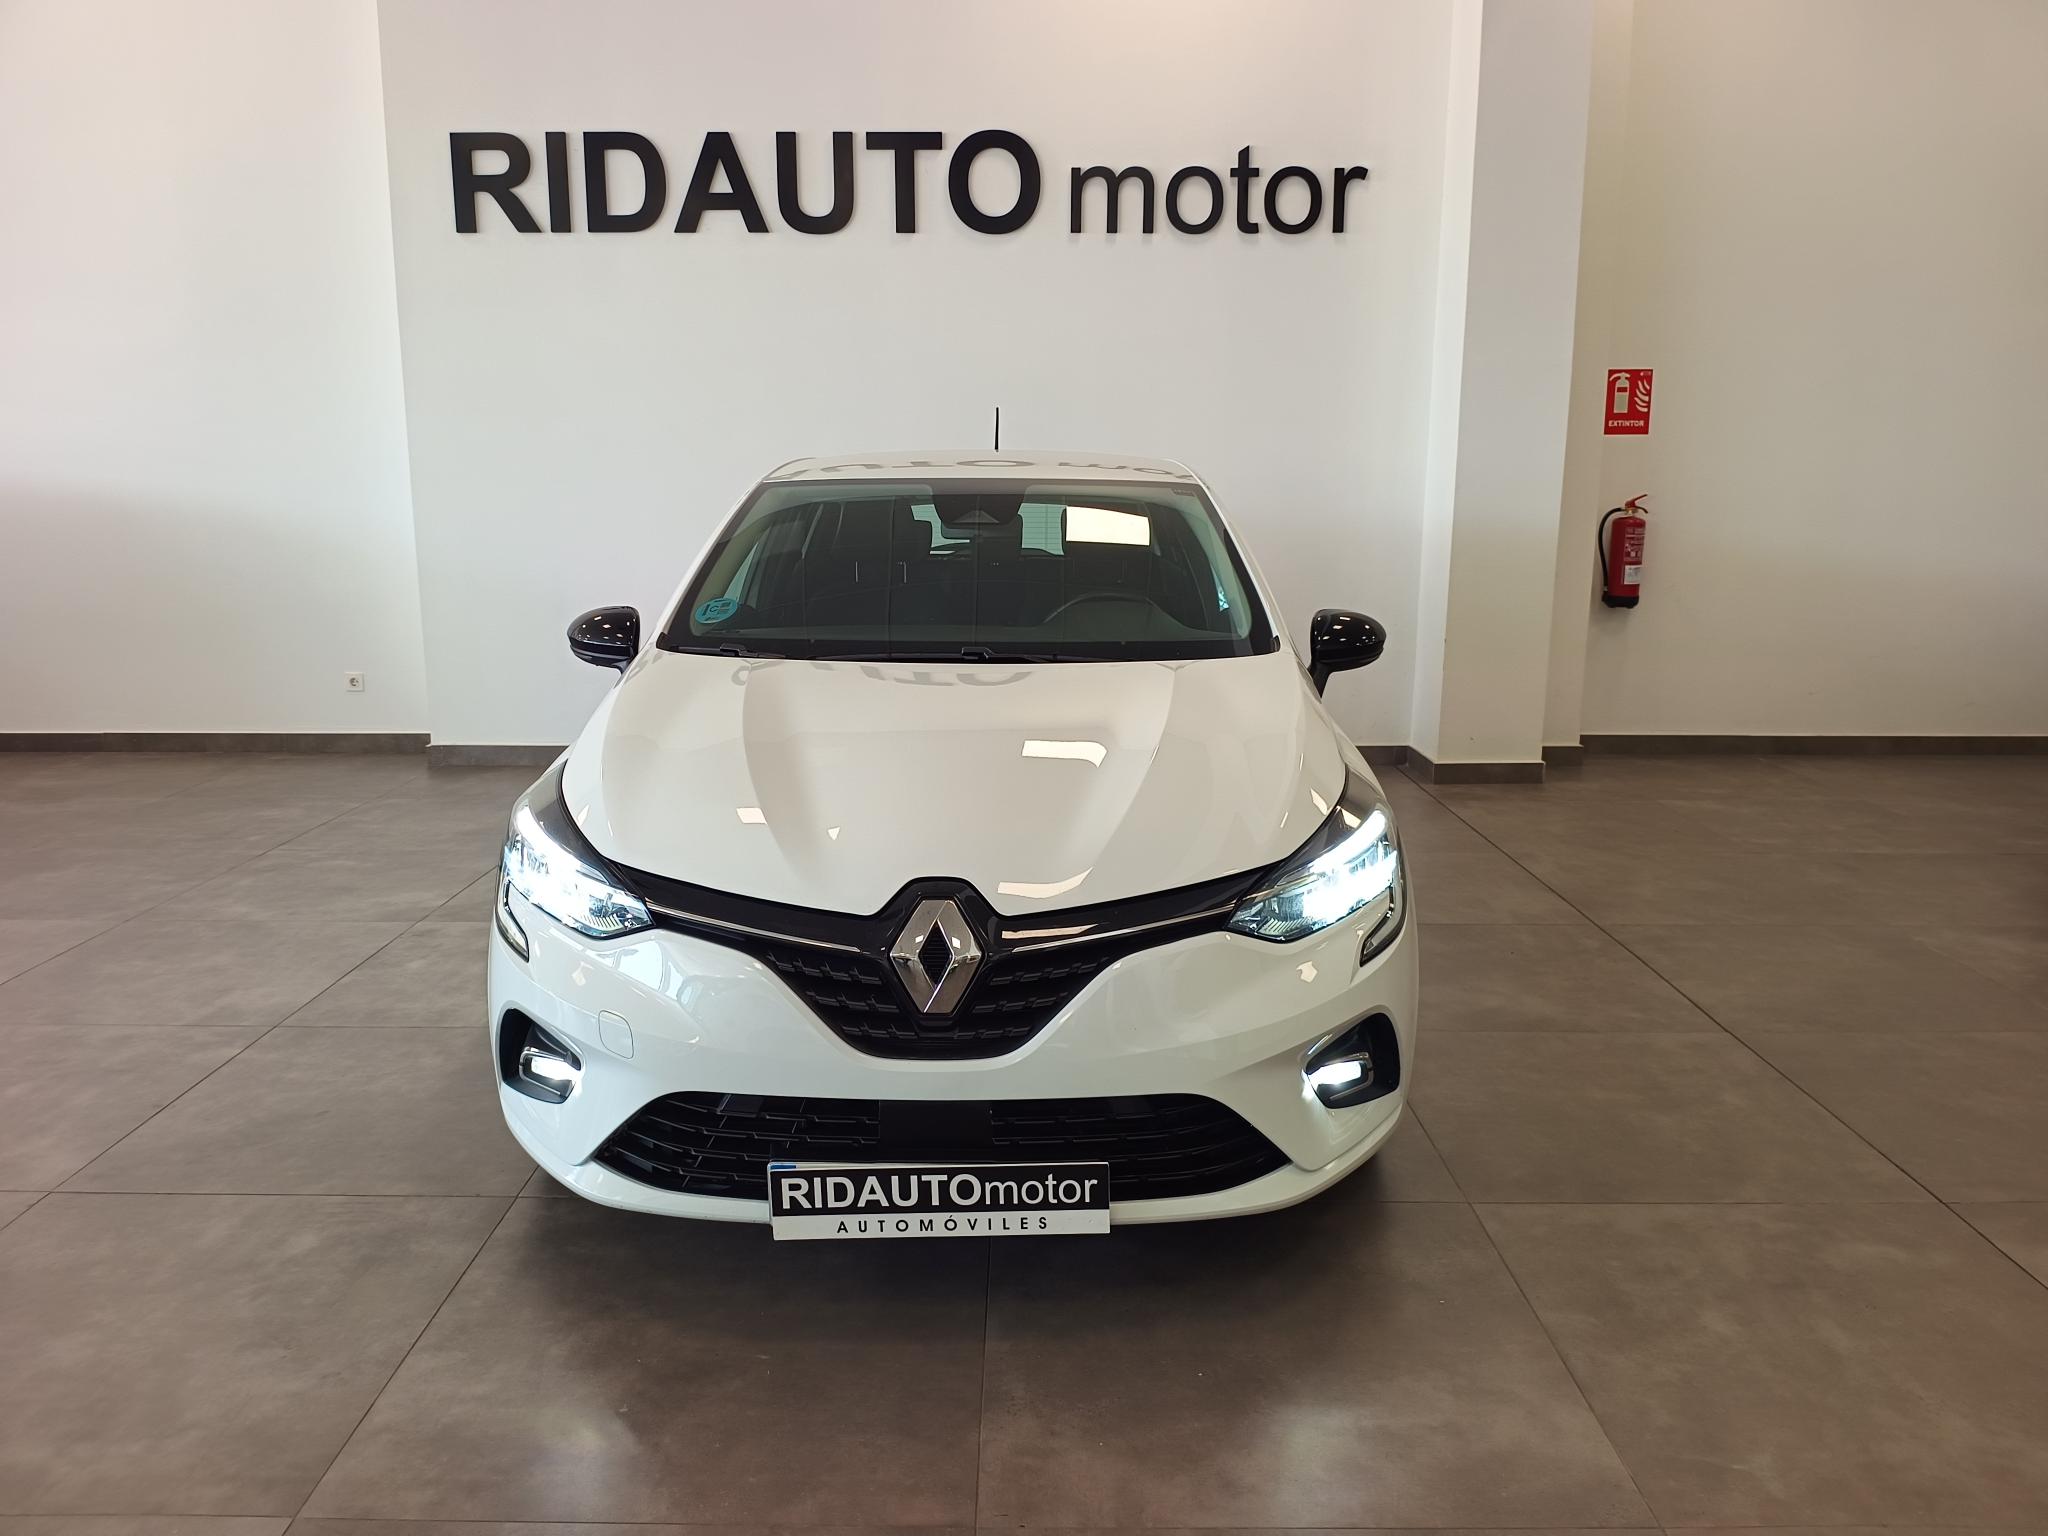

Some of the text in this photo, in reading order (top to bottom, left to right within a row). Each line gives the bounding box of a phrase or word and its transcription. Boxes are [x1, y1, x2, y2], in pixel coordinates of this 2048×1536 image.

[449, 130, 1369, 234] RIDAUTO motor
[781, 1174, 1098, 1210] RIDAUTOmotor
[837, 1215, 1047, 1233] AUTOMÓVILES
